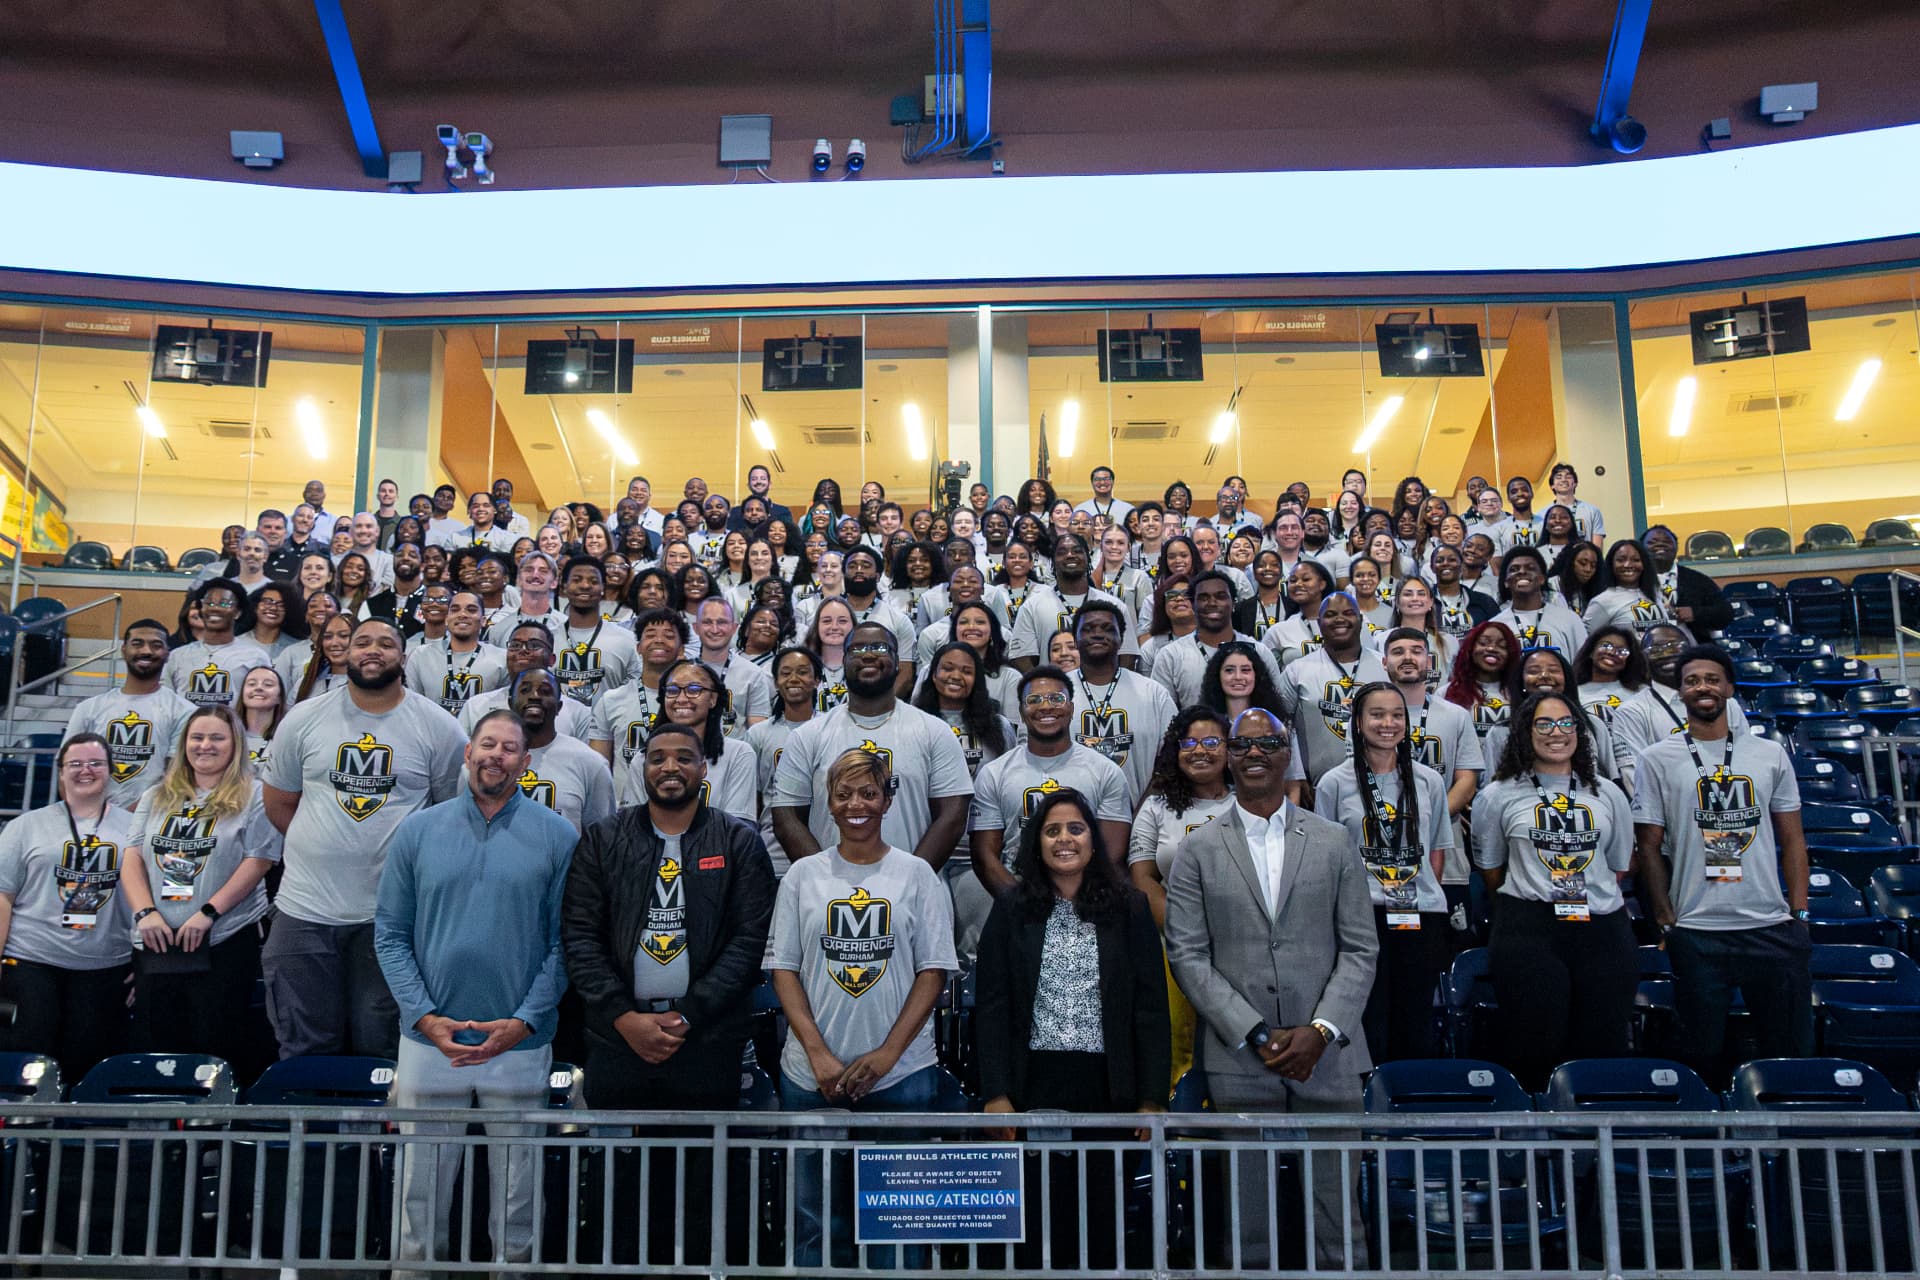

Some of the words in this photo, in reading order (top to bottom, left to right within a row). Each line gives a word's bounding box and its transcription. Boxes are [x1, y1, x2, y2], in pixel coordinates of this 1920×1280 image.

[193, 673, 226, 693] M
[111, 723, 149, 745] M
[343, 749, 389, 776] M
[331, 773, 394, 787] EXPERIENCE
[648, 921, 682, 930] DURHAM
[832, 904, 884, 937] M
[822, 938, 894, 953] EXPERIENCE
[838, 952, 874, 961] DURHAM
[378, 1071, 387, 1083] 11
[556, 1074, 567, 1086] 10
[1478, 1072, 1485, 1084] 5
[1660, 1071, 1668, 1083] 4
[991, 1152, 1018, 1160] PARK
[865, 1190, 1015, 1208] WARNING/ATENCIÓN
